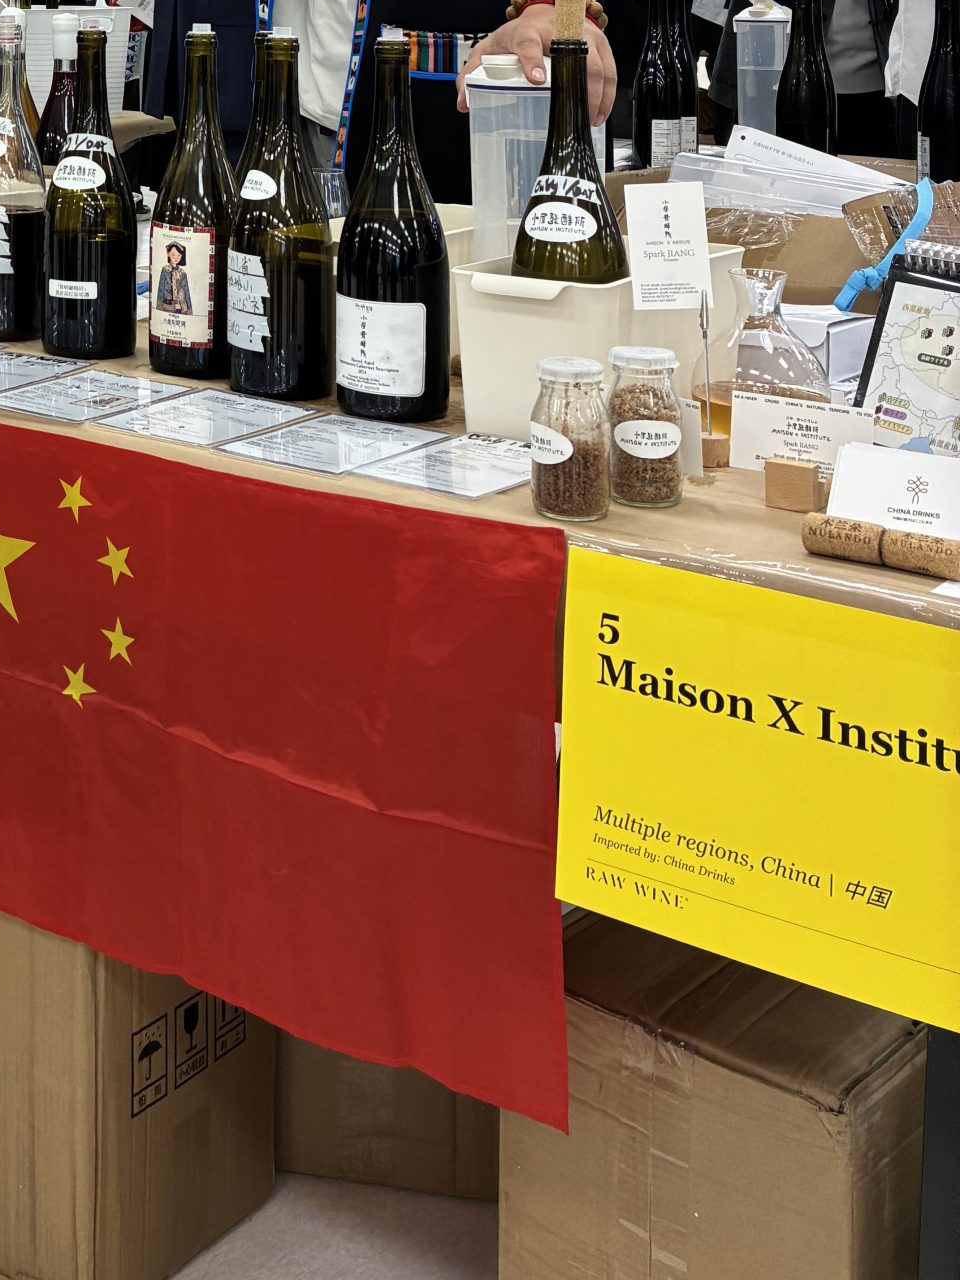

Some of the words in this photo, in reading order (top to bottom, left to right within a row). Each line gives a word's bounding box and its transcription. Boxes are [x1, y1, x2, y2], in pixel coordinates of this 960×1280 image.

[643, 250, 666, 260] Spark
[667, 249, 695, 258] JIANG
[887, 506, 911, 516] CHINA
[912, 510, 941, 520] DRINKS
[598, 612, 620, 645] 5
[596, 652, 755, 724] Maison
[767, 694, 805, 736] X
[592, 833, 641, 857] Imported
[643, 848, 661, 863] by:
[663, 855, 696, 874] China
[698, 865, 736, 886] Drinks
[593, 805, 672, 843] Multiple
[676, 833, 755, 872] regions,
[761, 856, 821, 889] China
[844, 880, 894, 910] 中国
[586, 866, 626, 890] RAW
